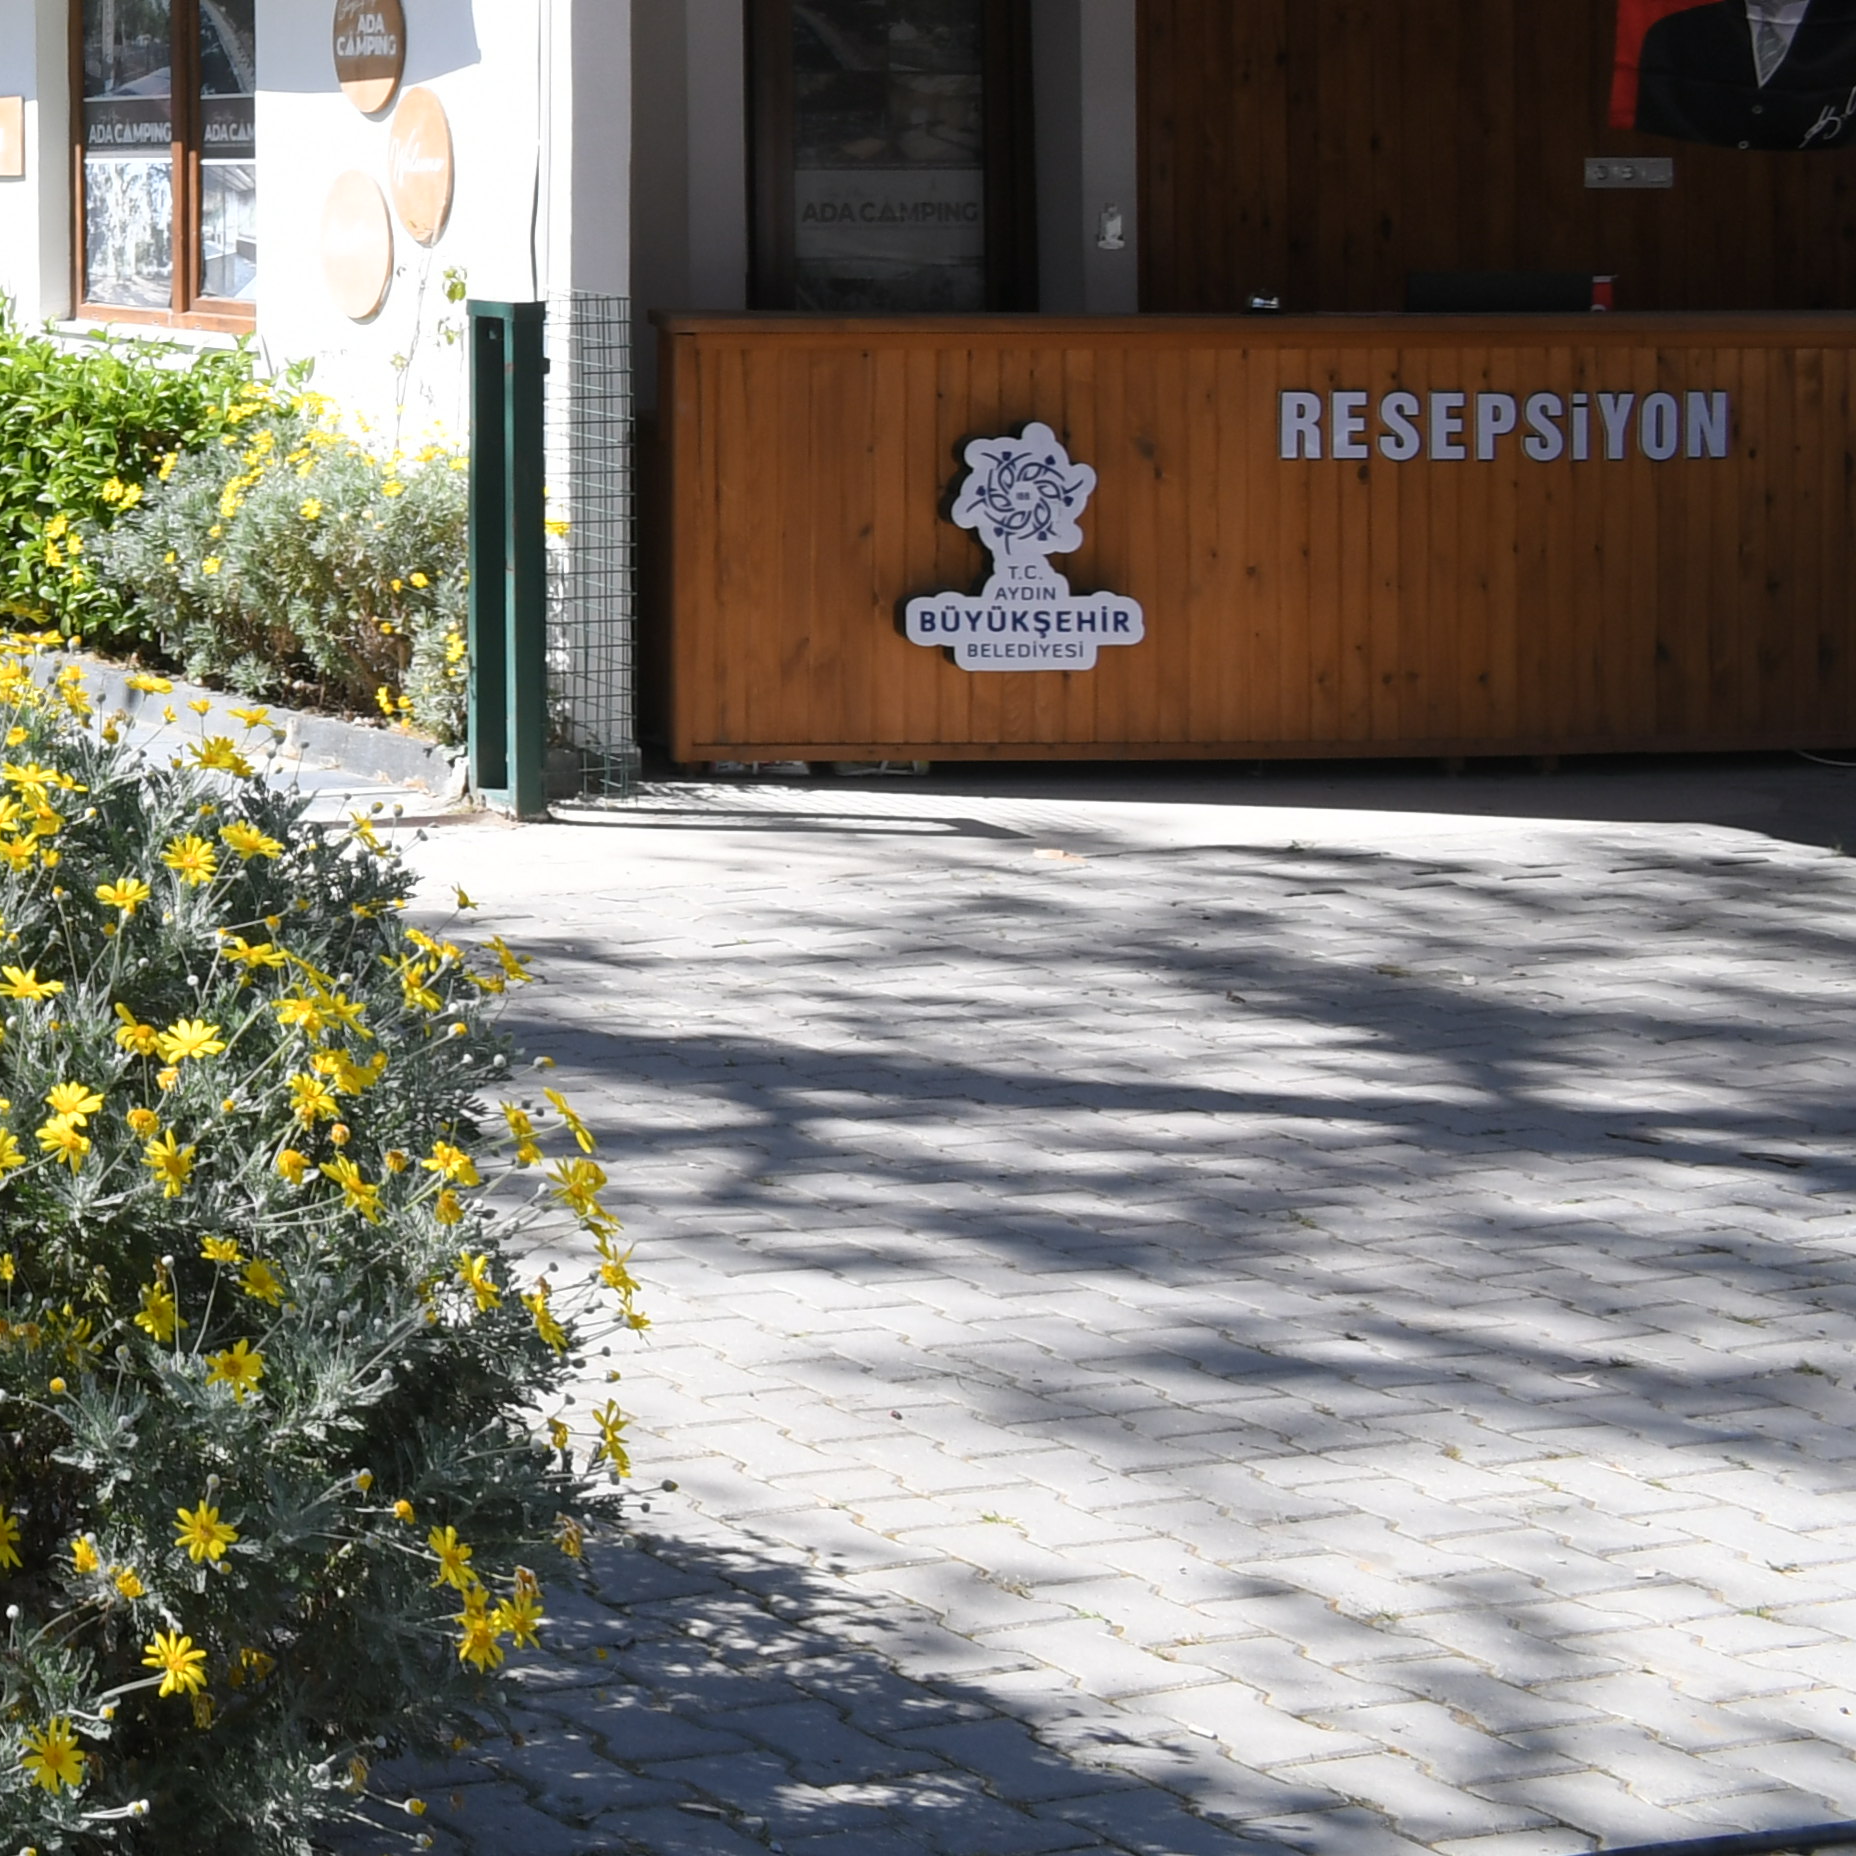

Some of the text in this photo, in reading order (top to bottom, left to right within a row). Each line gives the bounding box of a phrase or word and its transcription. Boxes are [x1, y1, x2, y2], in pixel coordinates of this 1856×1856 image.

[357, 13, 385, 34] ADA
[336, 31, 396, 56] CAMPING
[89, 120, 172, 143] ADA CAMPING
[204, 124, 228, 142] ADA
[801, 198, 978, 223] ADA CAMPING
[1007, 565, 1044, 580] T.C.
[994, 587, 1057, 600] AYDIN
[919, 605, 1131, 639] BÜYÜKŞEHİR
[966, 641, 1084, 658] BELEDİYESİ
